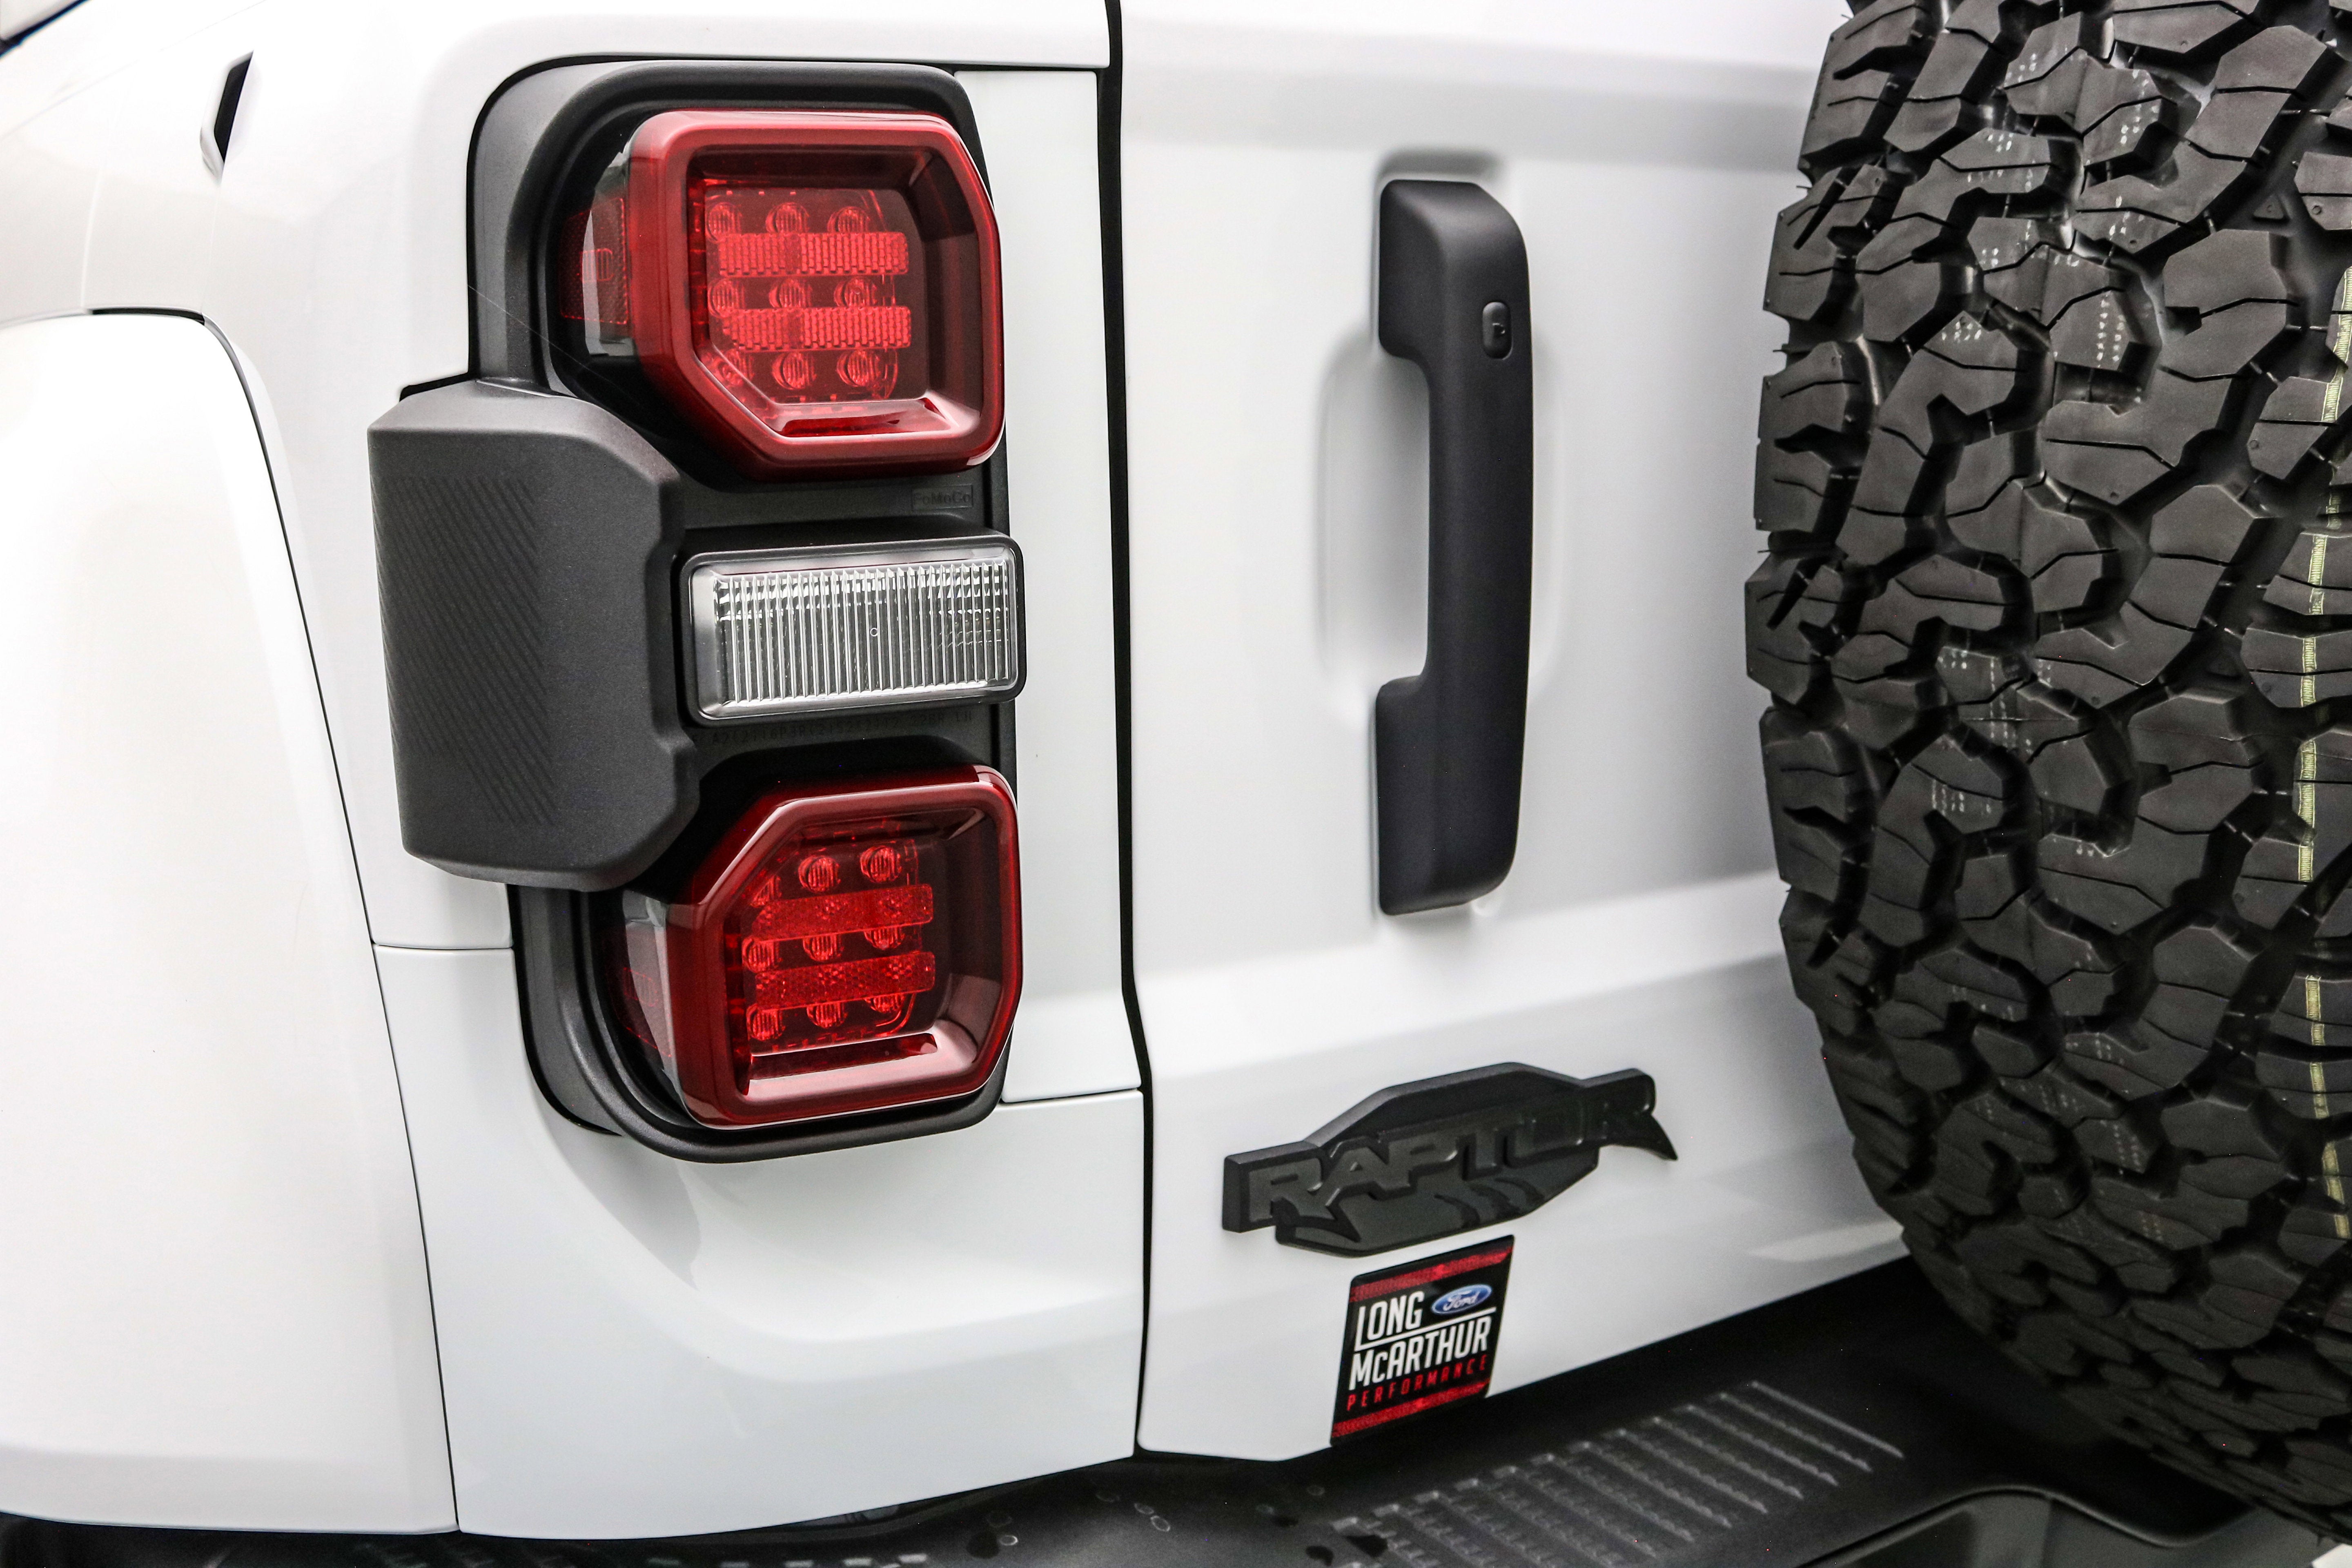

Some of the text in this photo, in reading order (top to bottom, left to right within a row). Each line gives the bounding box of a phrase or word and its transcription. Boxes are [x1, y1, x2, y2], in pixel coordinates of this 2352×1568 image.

[913, 490, 971, 506] FoMoCo
[1248, 1068, 1677, 1243] RAPTOR
[1354, 1290, 1425, 1352] LONG
[1347, 1354, 1487, 1411] PERFORMANCE
